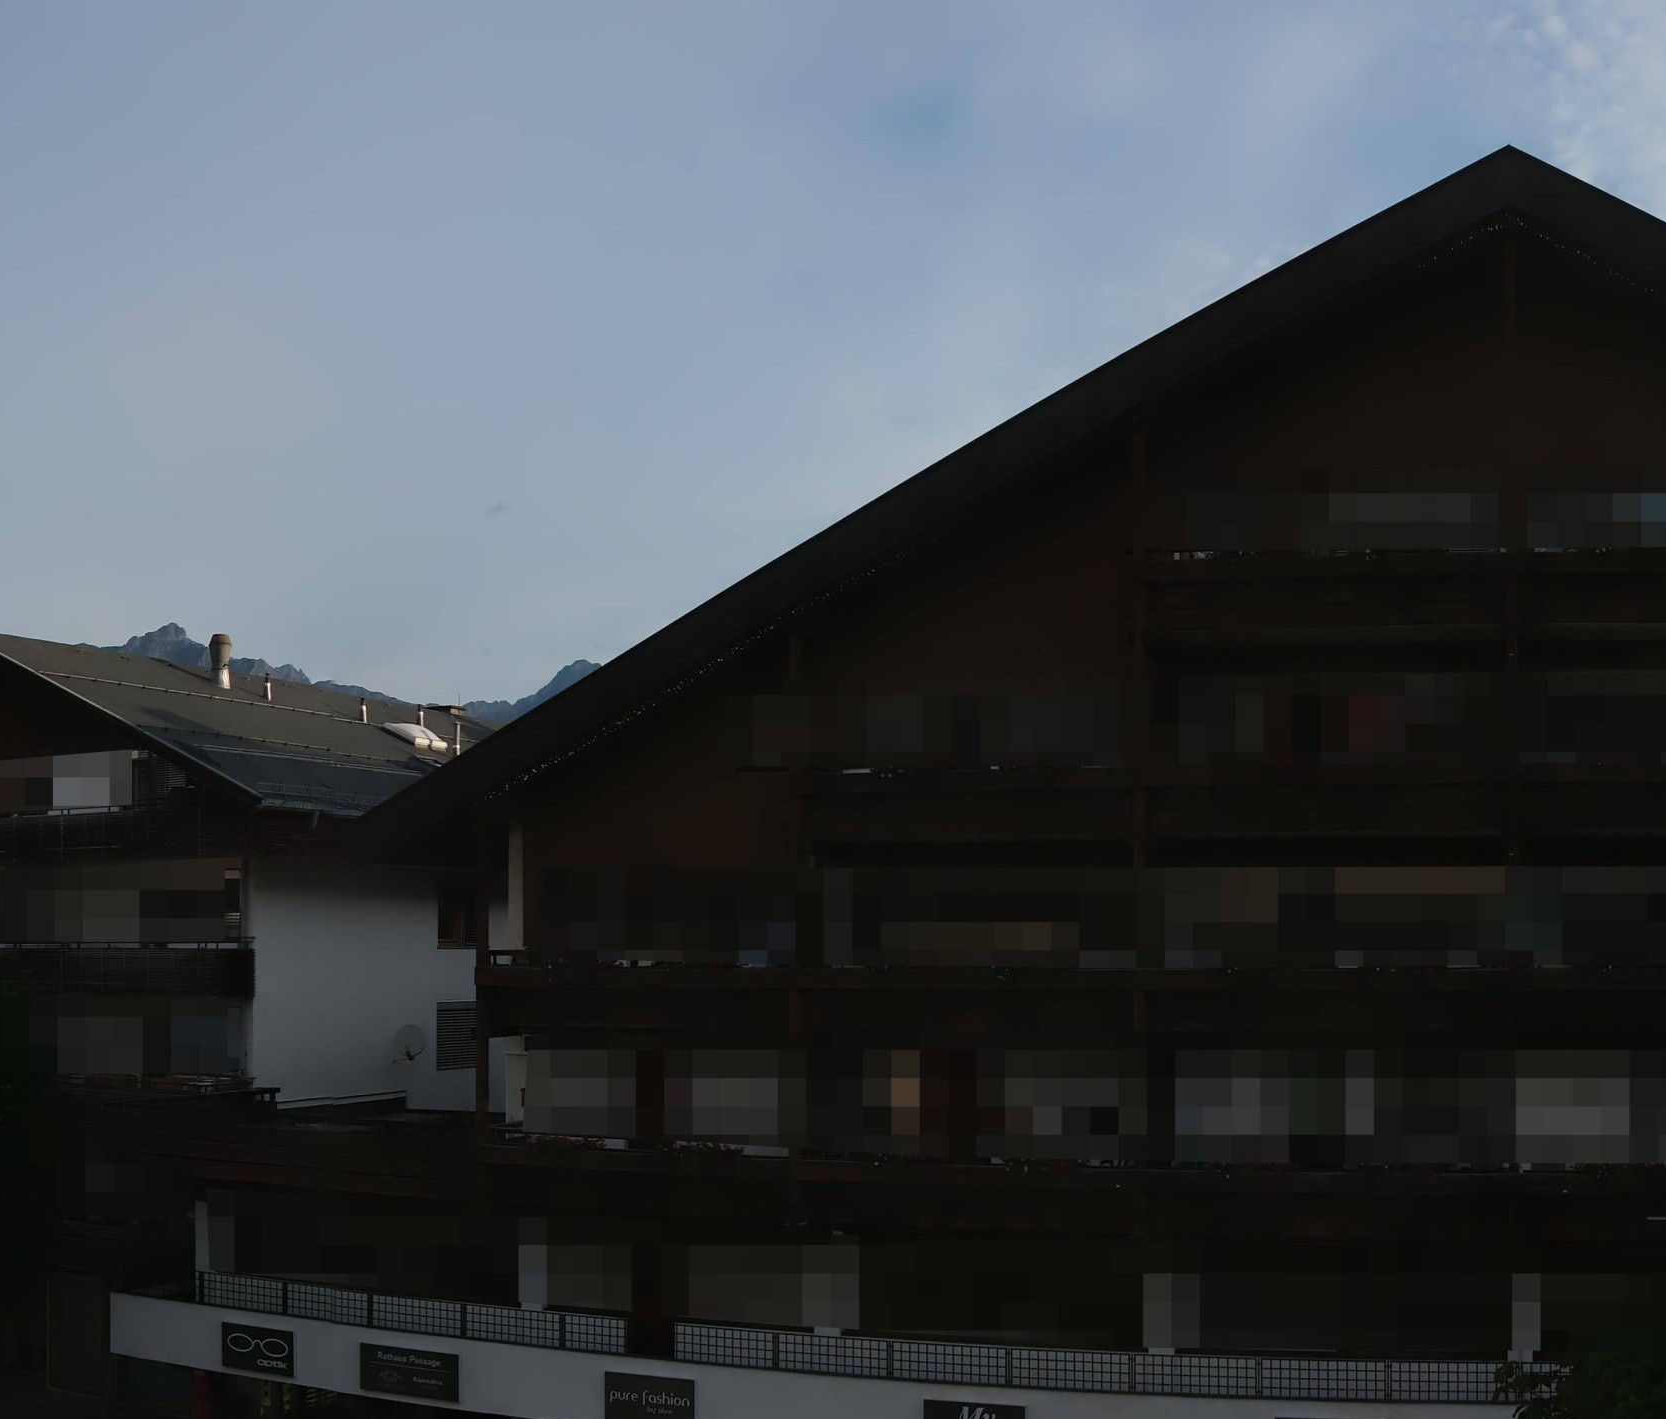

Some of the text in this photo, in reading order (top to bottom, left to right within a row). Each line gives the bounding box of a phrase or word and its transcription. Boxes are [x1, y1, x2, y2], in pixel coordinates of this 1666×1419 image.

[256, 1358, 289, 1370] optik
[377, 1351, 441, 1368] Rathaus Passage
[609, 1390, 690, 1408] pure fashion
